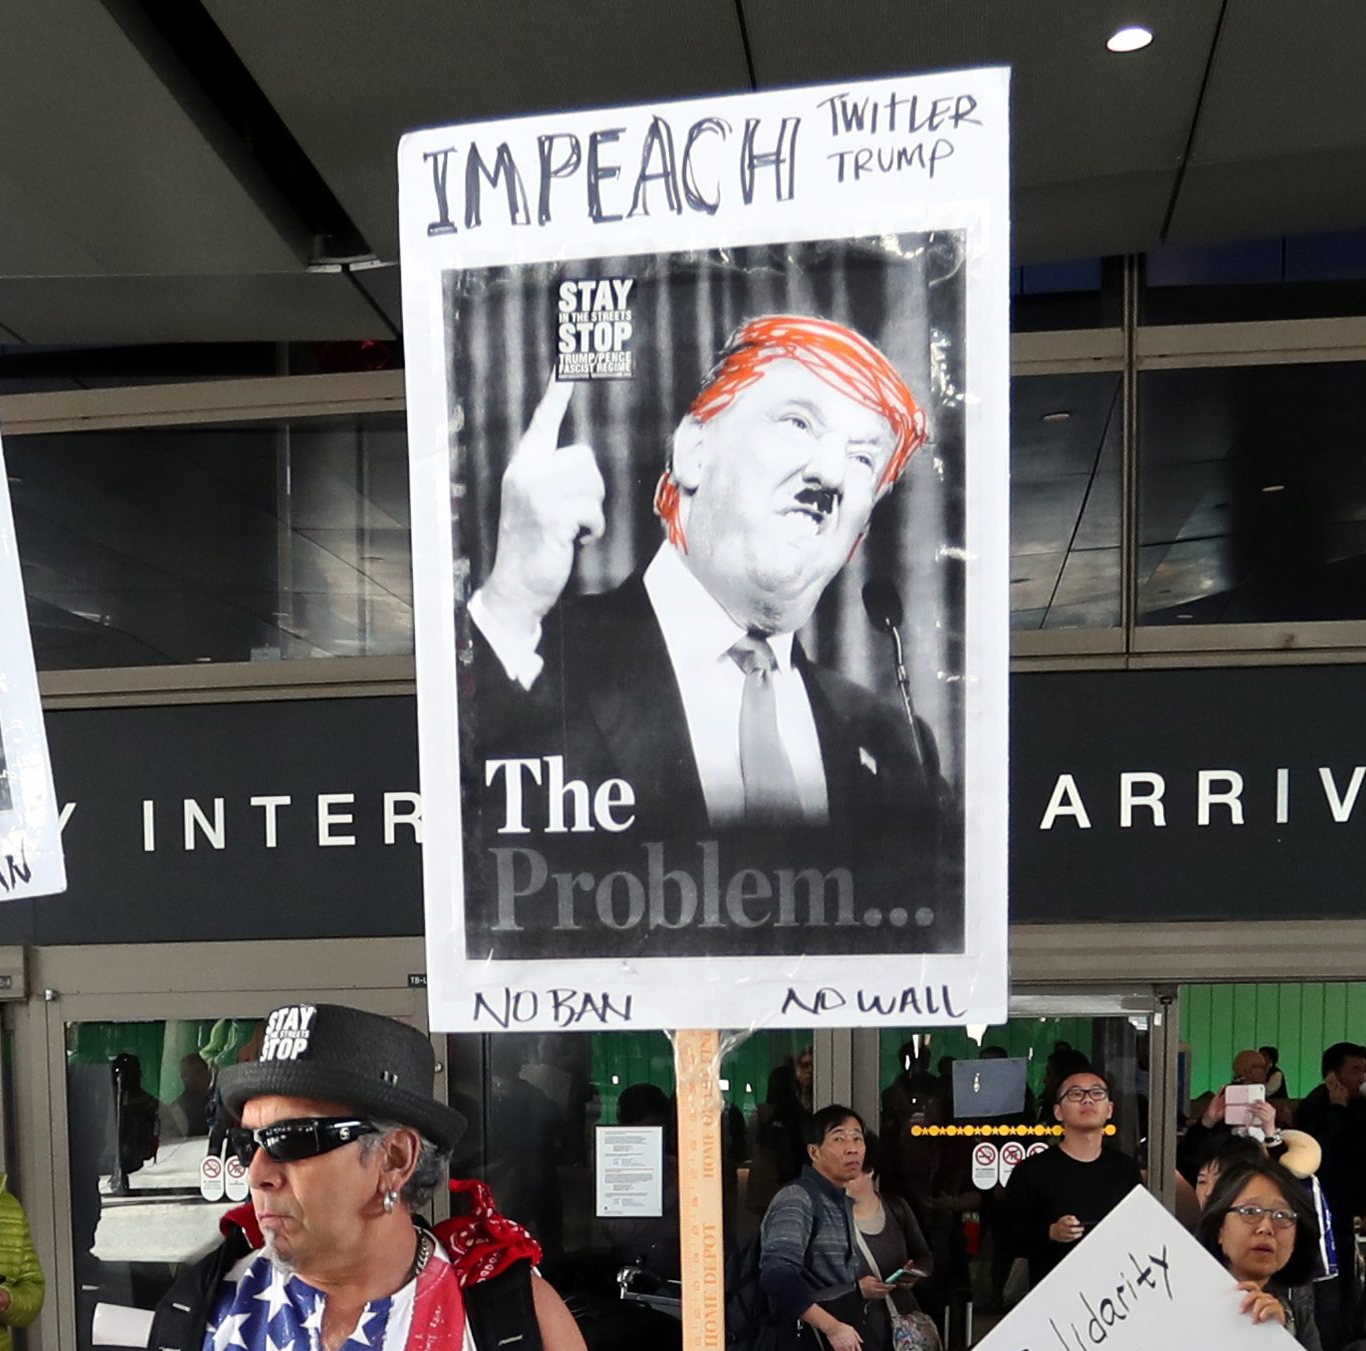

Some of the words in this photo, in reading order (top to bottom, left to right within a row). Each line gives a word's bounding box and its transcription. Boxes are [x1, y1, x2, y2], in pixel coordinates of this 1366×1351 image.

[816, 91, 985, 138] TWITLER
[423, 113, 803, 237] IMPEACH
[827, 137, 956, 182] TRUMP
[558, 279, 633, 313] STAY
[571, 312, 589, 323] THE
[591, 310, 632, 322] STREETS
[558, 321, 633, 353] STOP
[484, 754, 636, 834] The
[488, 841, 936, 934] Problem...
[265, 1006, 315, 1035] STAY
[473, 986, 540, 1030] NO
[551, 989, 635, 1028] BAN
[781, 986, 847, 1014] NO
[857, 985, 968, 1018] WALL
[259, 1037, 308, 1063] STOP
[703, 1135, 715, 1178] HOME
[702, 1221, 717, 1285] DEPOT
[704, 1295, 718, 1346] HOME
